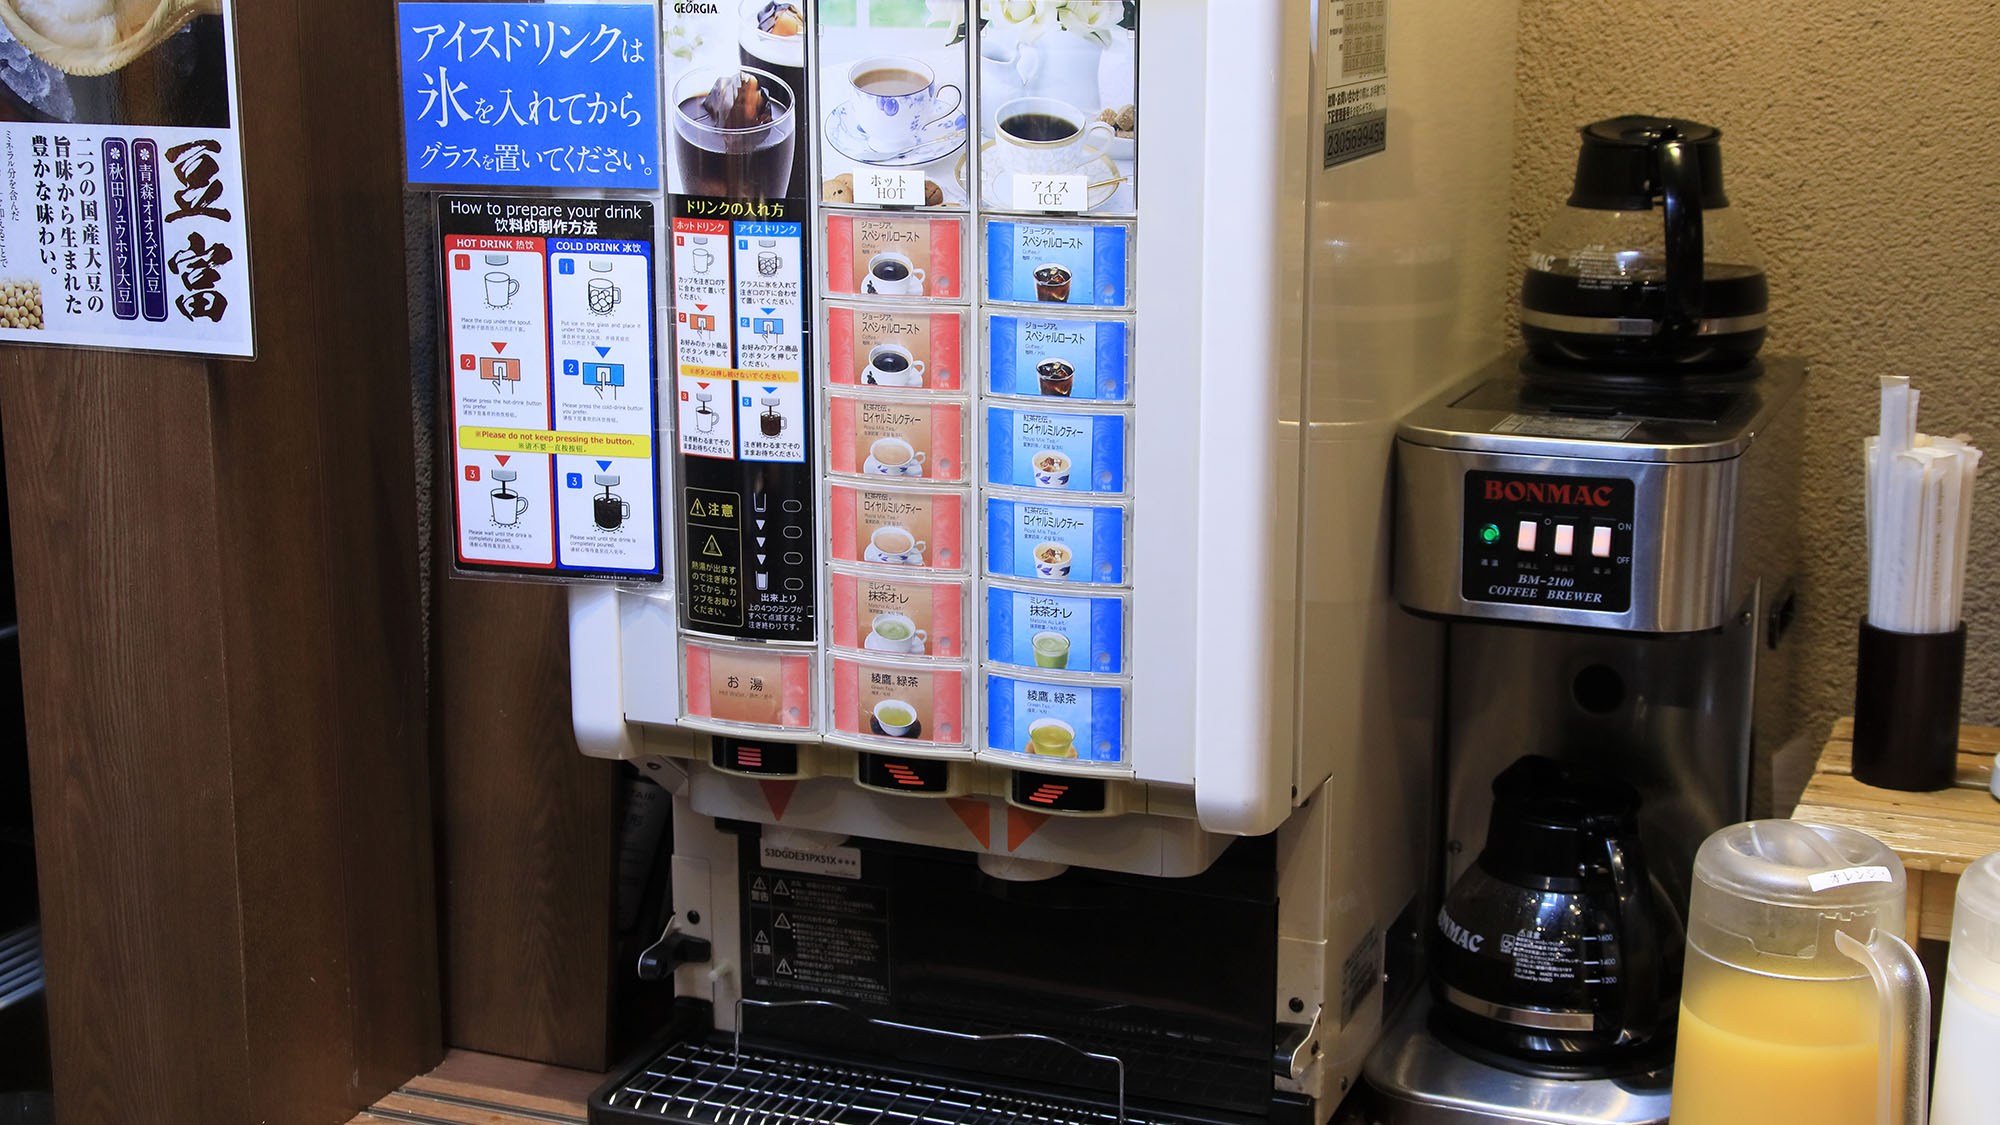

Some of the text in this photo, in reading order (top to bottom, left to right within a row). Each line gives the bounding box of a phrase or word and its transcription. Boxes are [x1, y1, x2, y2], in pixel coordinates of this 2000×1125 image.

[673, 3, 718, 14] GEORGIA
[412, 20, 645, 65] アイスドリンクは
[417, 66, 641, 128] 氷を入れてから
[420, 141, 652, 176] グラスを置いてください。
[870, 174, 906, 188] ホット
[1031, 180, 1069, 193] アイス
[877, 187, 906, 200] HOT
[1038, 193, 1063, 206] ICE
[31, 135, 58, 276] 豊かな味わい。
[451, 200, 642, 222] How to prepare your drink
[687, 200, 785, 217] ドリンクの入れ方
[54, 135, 82, 315] 旨味から生まれた
[76, 137, 104, 314] 二つの国産大豆の
[138, 164, 161, 294] 青森オオスズ大豆
[164, 139, 233, 323] 豆富
[494, 217, 598, 235] 饮料的制作方法
[676, 221, 725, 232] ホットドリンク
[738, 224, 797, 235] アイスドリンク
[108, 163, 132, 305] 秋田リュウホウ大豆
[861, 230, 920, 242] スペシャルロースト
[456, 239, 477, 248] HOT
[480, 239, 513, 249] DRINK
[556, 241, 642, 253] COLD DRINK 冰饮
[1022, 236, 1083, 249] スペシャルロースト
[679, 277, 726, 286] カップを注ぎ口の下
[740, 281, 797, 289] グラスに氷を入れて
[679, 285, 726, 294] に合わせて置いて
[740, 289, 797, 297] 注ぎ口の下に合わせ
[740, 297, 795, 305] て置いてください。
[862, 322, 920, 334] スペシャルロースト
[1025, 331, 1085, 344] スペシャルロースト
[680, 339, 728, 349] お好みのホット商品
[742, 344, 798, 352] お好みのアイス商品
[680, 347, 727, 358] のボタンを押して
[742, 352, 798, 360] のボタンを押して
[681, 355, 704, 364] ください。
[743, 360, 770, 368] ください。
[863, 413, 921, 425] ロイヤルミルクティー
[1023, 423, 1084, 437] ロイヤルミルクティー
[520, 433, 533, 441] not
[535, 433, 554, 443] keep
[556, 435, 588, 445] pressing
[590, 436, 604, 444] the
[606, 437, 635, 446] button.
[683, 435, 730, 446] 注ぎ終わるまでその
[744, 441, 800, 449] 注ぎ終わるまでその
[744, 449, 801, 458] ままお待ちください。
[469, 469, 476, 479] 3
[571, 477, 578, 486] 3
[1484, 480, 1613, 507] BONMAC
[708, 502, 733, 518] 注意
[864, 501, 922, 514] ロイヤルミルクティー
[1024, 515, 1084, 529] ロイヤルミルクティー
[1618, 522, 1631, 530] ON
[1617, 556, 1630, 564] OFF
[692, 573, 737, 586] ので注ぎ終わ
[1518, 574, 1574, 587] BM-2100
[760, 593, 797, 603] 出来上り
[868, 591, 909, 604] 抹茶オ・レ
[1488, 585, 1602, 603] COFFEE BREWER
[693, 606, 726, 617] ください。
[748, 604, 803, 613] 上の4つのランプが
[1030, 605, 1072, 618] 抹茶オ・レ
[748, 621, 800, 631] 注ぎ終わりです。
